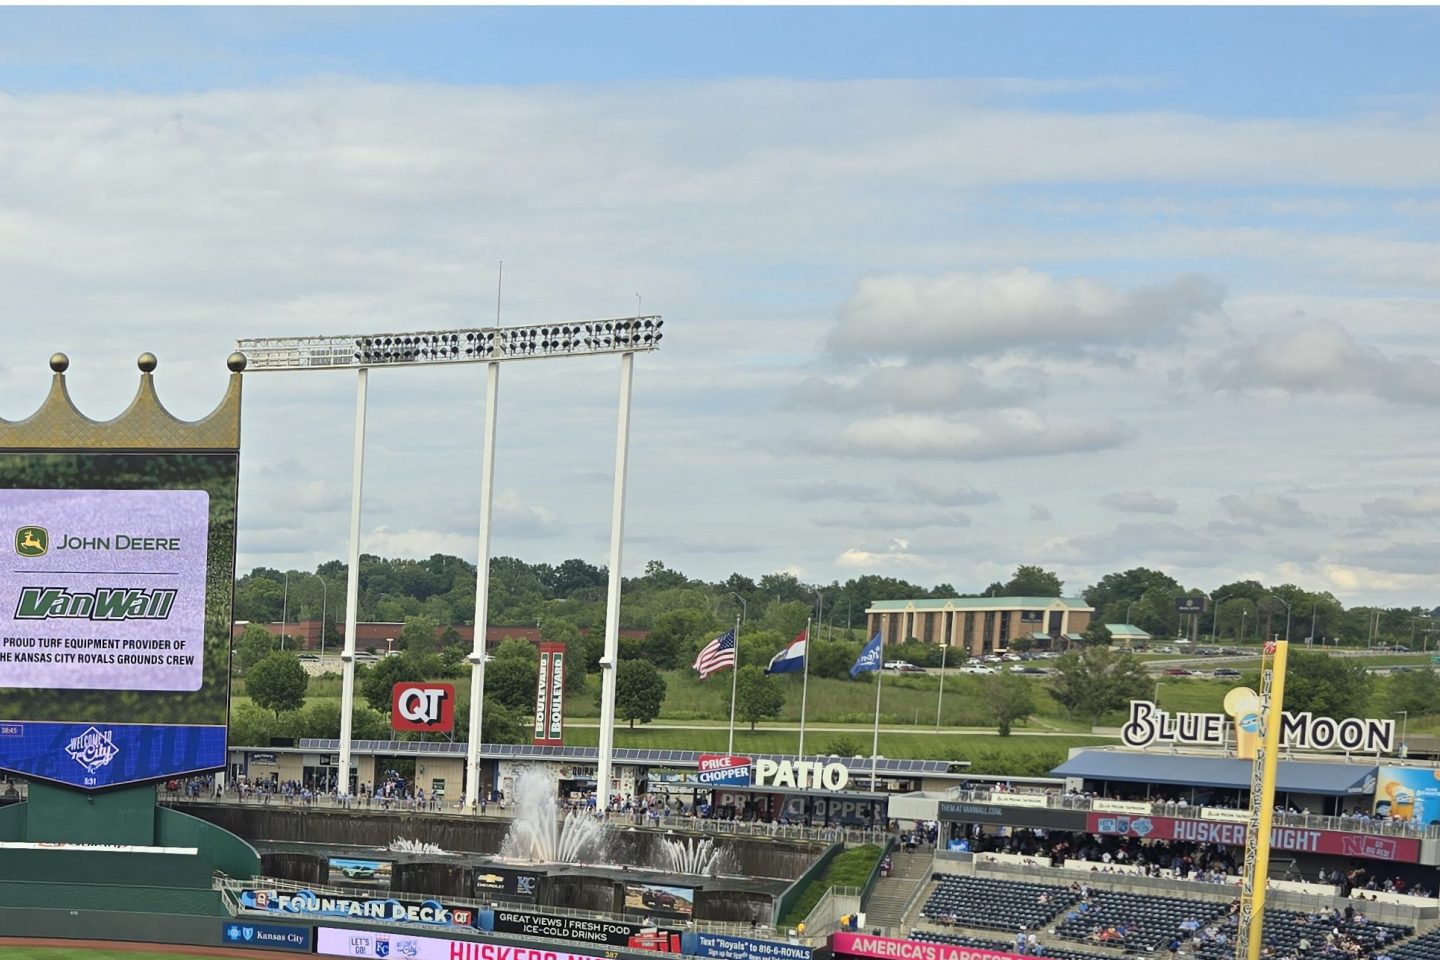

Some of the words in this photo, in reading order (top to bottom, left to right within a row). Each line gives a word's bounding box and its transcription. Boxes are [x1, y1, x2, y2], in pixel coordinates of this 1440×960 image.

[57, 534, 110, 550] JOHN
[116, 535, 181, 550] DEERE
[3, 637, 35, 647] PROUD
[38, 638, 62, 648] TURF
[65, 638, 120, 649] EQUIPMENT
[123, 640, 171, 649] PROVIDER
[173, 640, 186, 650] OF
[14, 653, 52, 663] KANSAS
[54, 653, 75, 663] CITY
[78, 653, 115, 664] ROYALS
[117, 654, 163, 665] GROUNDS
[166, 655, 194, 665] CREW
[536, 658, 547, 732] BOULEVARD
[551, 659, 562, 732] BOULEVARD
[398, 687, 444, 723] QT
[1122, 700, 1224, 747] BLUE
[1281, 711, 1395, 752] MOON
[701, 757, 731, 770] PRICE
[699, 767, 749, 783] CHOPPER
[756, 759, 849, 791] PATIO
[517, 875, 535, 892] KC
[278, 895, 386, 917] FOUNTAIN
[392, 905, 449, 923] DECK
[454, 911, 469, 924] QT
[500, 913, 530, 924] GREAT
[532, 916, 563, 928] VIEWS
[569, 920, 601, 932] FRESH
[603, 924, 631, 935] FOOD
[256, 930, 285, 941] Kansas
[288, 932, 304, 943] City
[523, 925, 569, 937] ICE-COLD
[572, 929, 607, 942] DRINKS
[351, 938, 369, 946] LET'S
[376, 941, 389, 955] KC
[700, 936, 715, 946] Text
[716, 938, 749, 951] "Royals"
[750, 943, 757, 952] to
[758, 944, 810, 959] 816-6-ROYALS
[355, 946, 366, 955] GO!
[605, 951, 619, 959] 387
[708, 948, 719, 957] Sign
